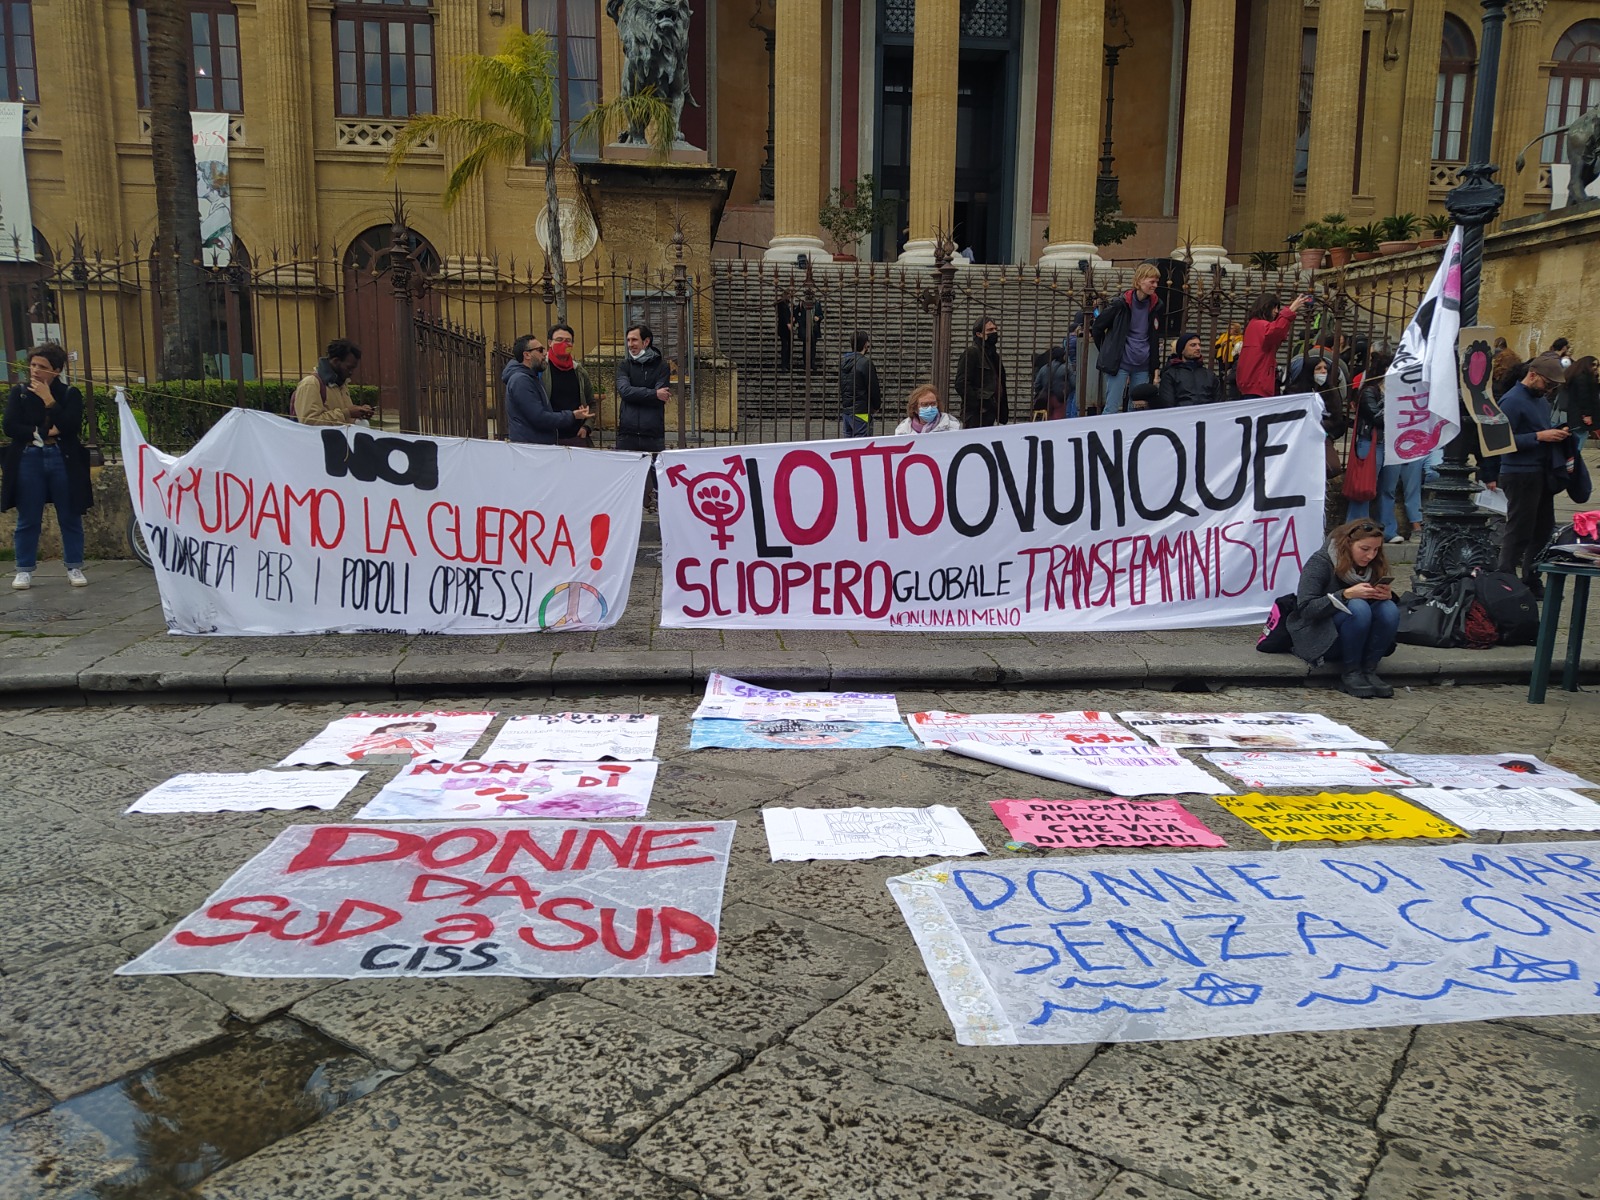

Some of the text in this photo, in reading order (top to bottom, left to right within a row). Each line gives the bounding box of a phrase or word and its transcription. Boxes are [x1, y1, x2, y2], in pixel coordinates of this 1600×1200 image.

[745, 408, 1307, 558] LOTTO OVUNQUE
[138, 443, 346, 549] RIPUDIAMO
[363, 496, 417, 557] LA
[427, 501, 577, 567] GUERRA
[145, 523, 534, 624] OLIDARIETÀ PER I POPOLI OPPRESSI
[675, 557, 893, 620] SCIOPERO
[892, 561, 1014, 603] GLOBALE
[733, 685, 792, 698] SESSO
[409, 761, 530, 776] NON
[441, 775, 555, 791] UNA
[1034, 834, 1065, 844] DI
[1047, 823, 1186, 833] CHE VITA
[1304, 823, 1394, 835] LIBERE
[286, 825, 717, 874] DONNE
[408, 873, 542, 909] DA
[952, 863, 1304, 912] DONNE
[1321, 858, 1425, 892] DI
[174, 895, 402, 946] SUD
[519, 897, 718, 964] SUD
[987, 909, 1389, 975] SENZA
[359, 942, 501, 972] CISS
